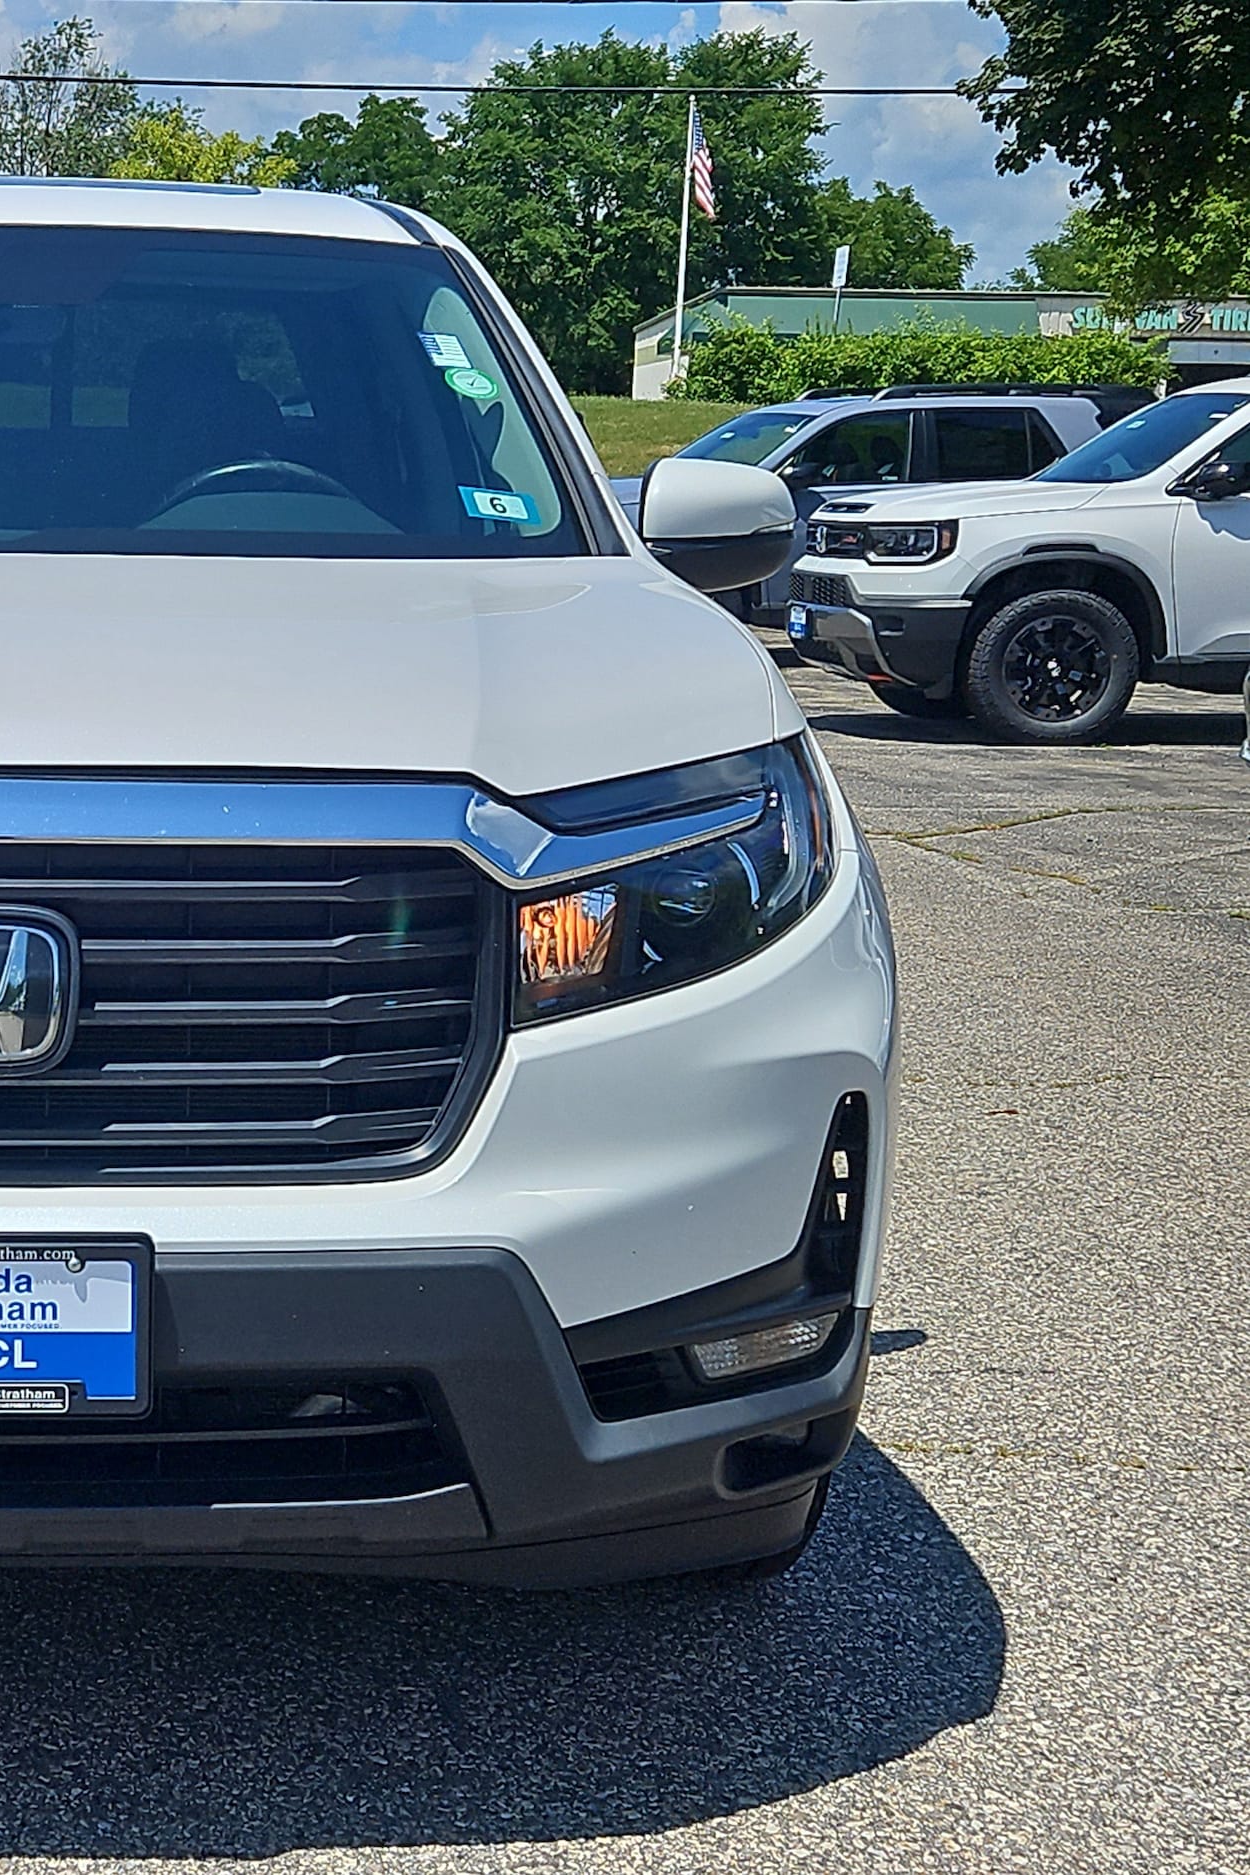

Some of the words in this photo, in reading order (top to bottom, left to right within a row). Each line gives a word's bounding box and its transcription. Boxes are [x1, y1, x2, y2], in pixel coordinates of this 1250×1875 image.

[1071, 306, 1179, 332] SUVAN
[1210, 307, 1250, 333] TIR
[489, 497, 507, 514] 6
